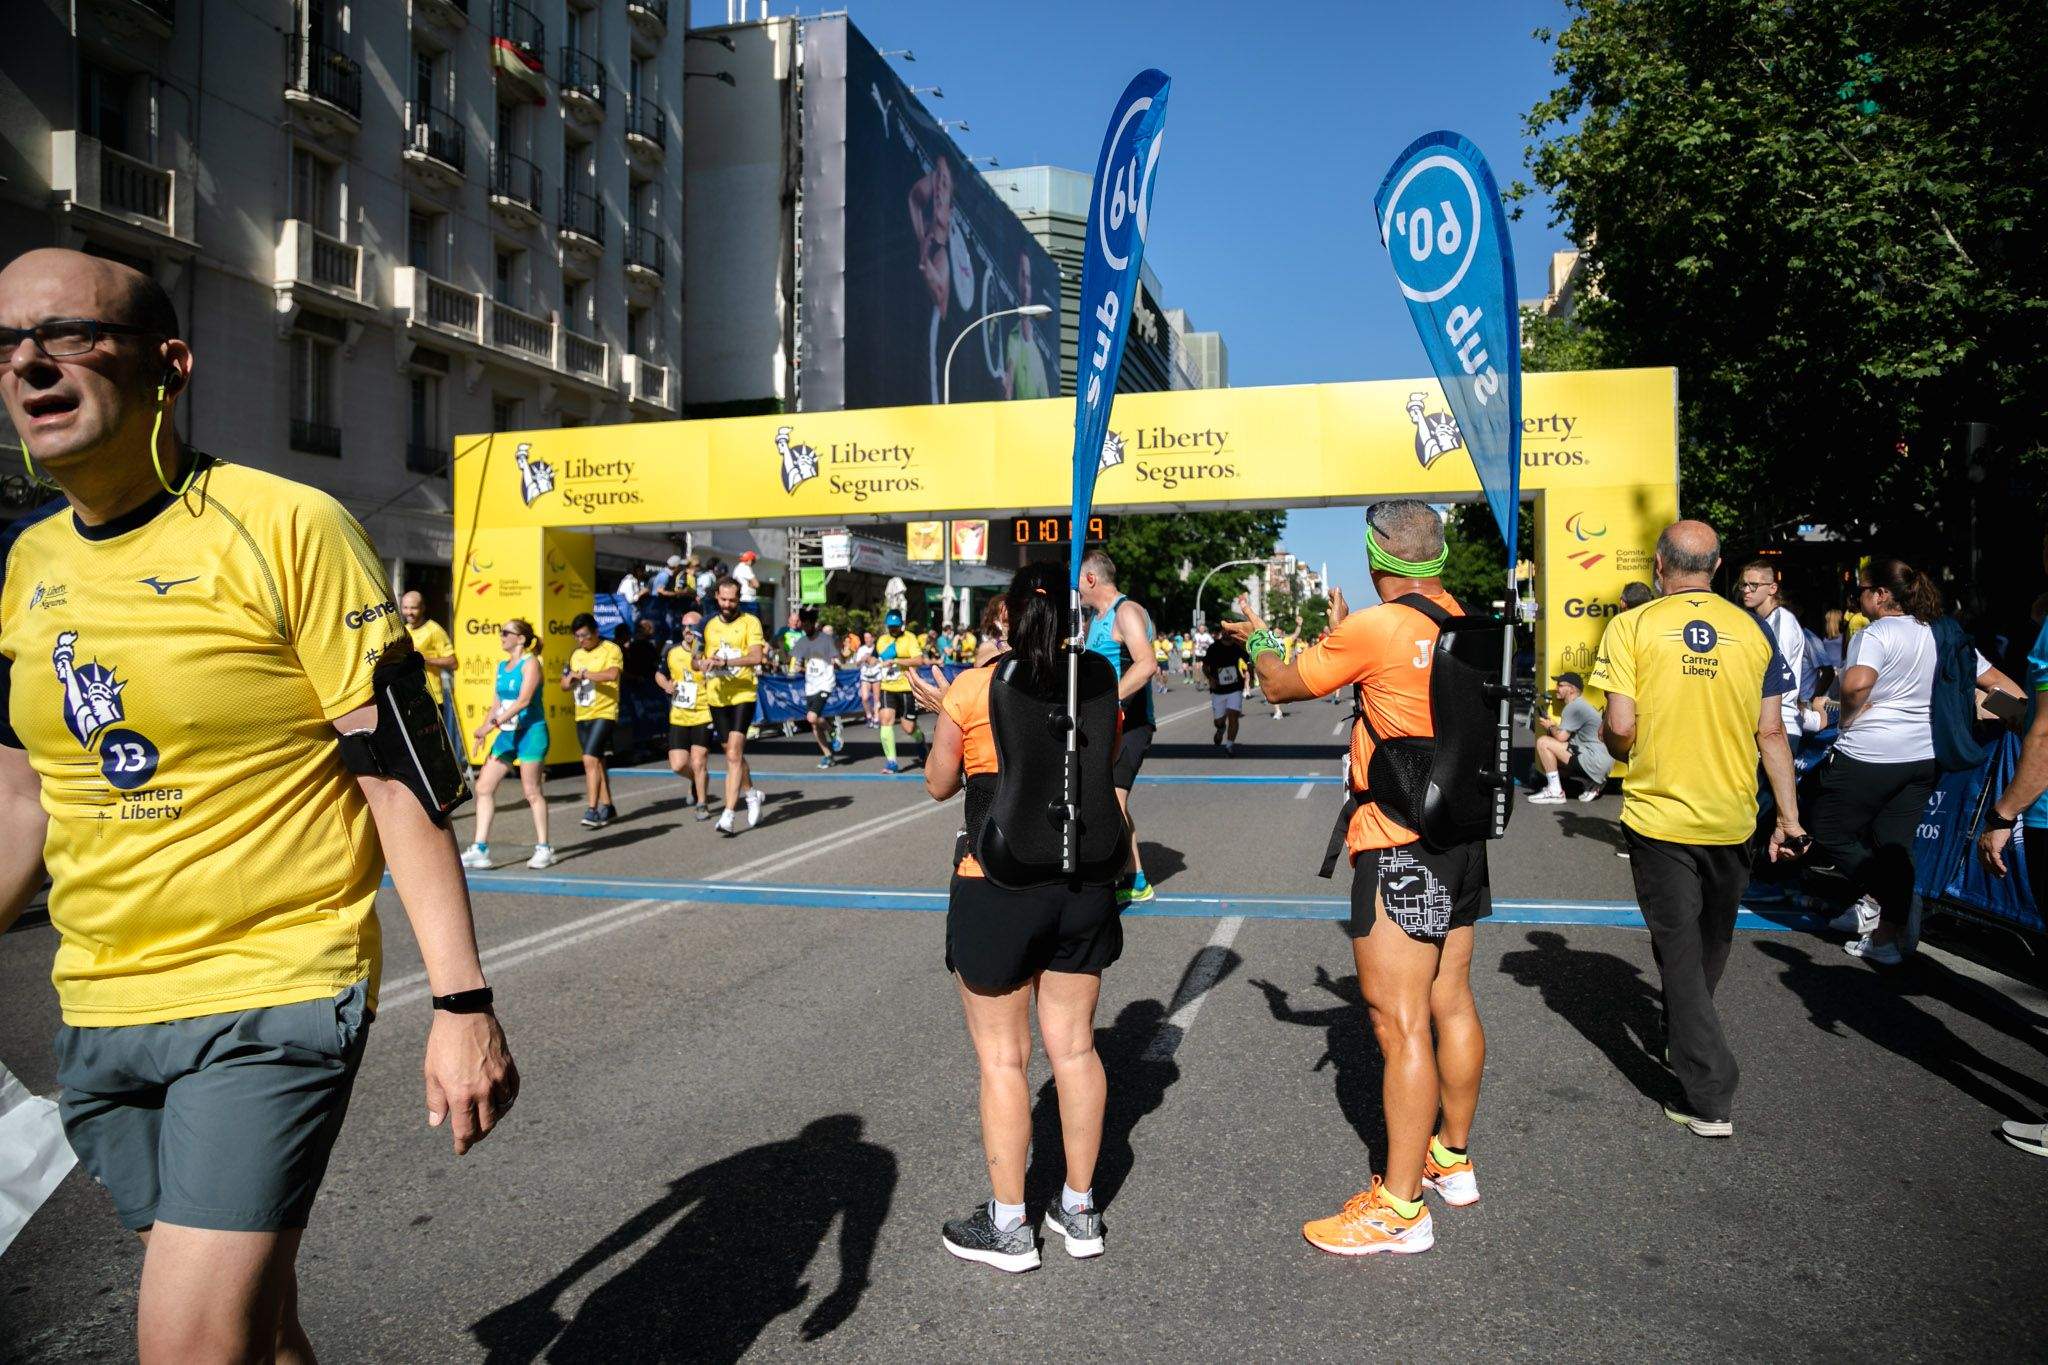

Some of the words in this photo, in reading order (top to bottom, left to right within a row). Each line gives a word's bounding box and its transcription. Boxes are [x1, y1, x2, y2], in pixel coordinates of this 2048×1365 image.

[1086, 290, 1119, 410] sub
[1522, 413, 1578, 443] erty
[1136, 426, 1229, 456] Liberty
[831, 442, 915, 470] Liberty
[565, 457, 635, 484] Liberty
[345, 601, 395, 629] Géne
[1564, 597, 1619, 618] Gén
[467, 618, 502, 635] Gén
[1689, 627, 1710, 645] 13
[1681, 654, 1718, 667] Carrera
[1682, 665, 1717, 680] Liberty
[109, 742, 147, 772] 13
[121, 789, 183, 802] Carrera
[121, 804, 182, 820] Liberty
